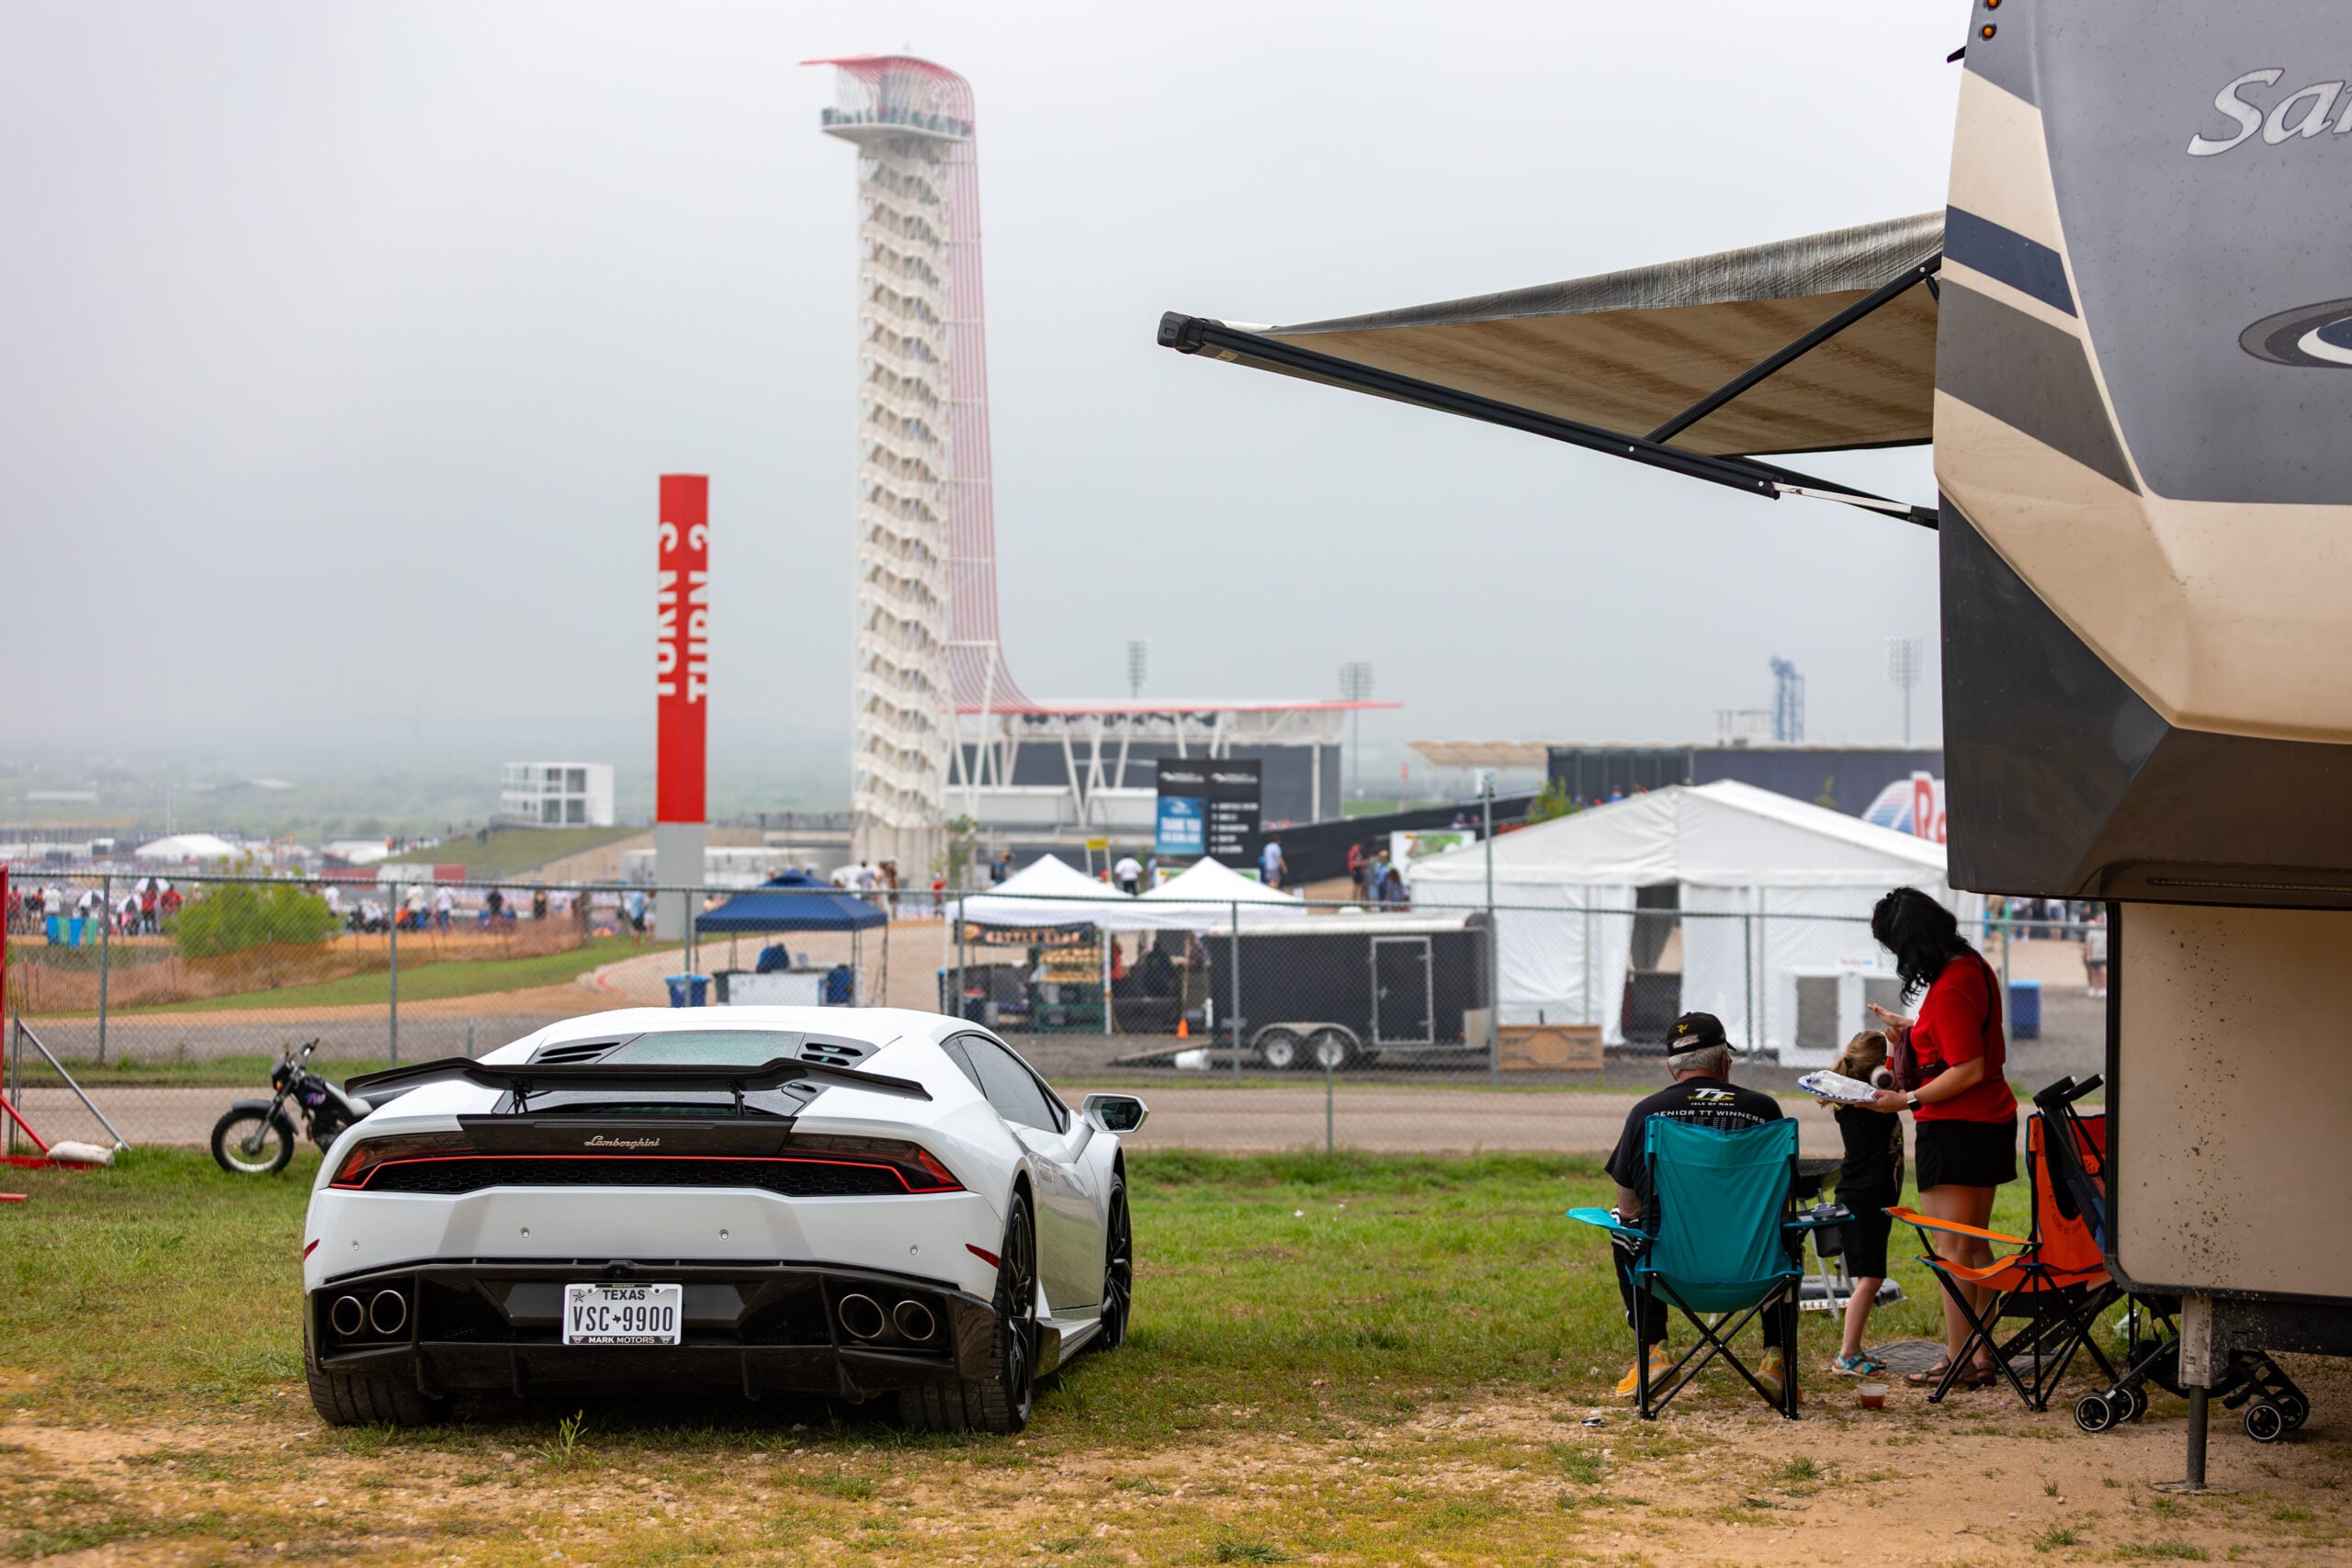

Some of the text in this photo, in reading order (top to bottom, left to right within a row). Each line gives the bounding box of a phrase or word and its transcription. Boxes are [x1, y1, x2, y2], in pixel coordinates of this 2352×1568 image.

[1694, 1088, 1736, 1102] TT
[1716, 1111, 1765, 1125] WINNERS
[583, 1135, 661, 1149] Lamborghini
[602, 1289, 646, 1301] TEXAS
